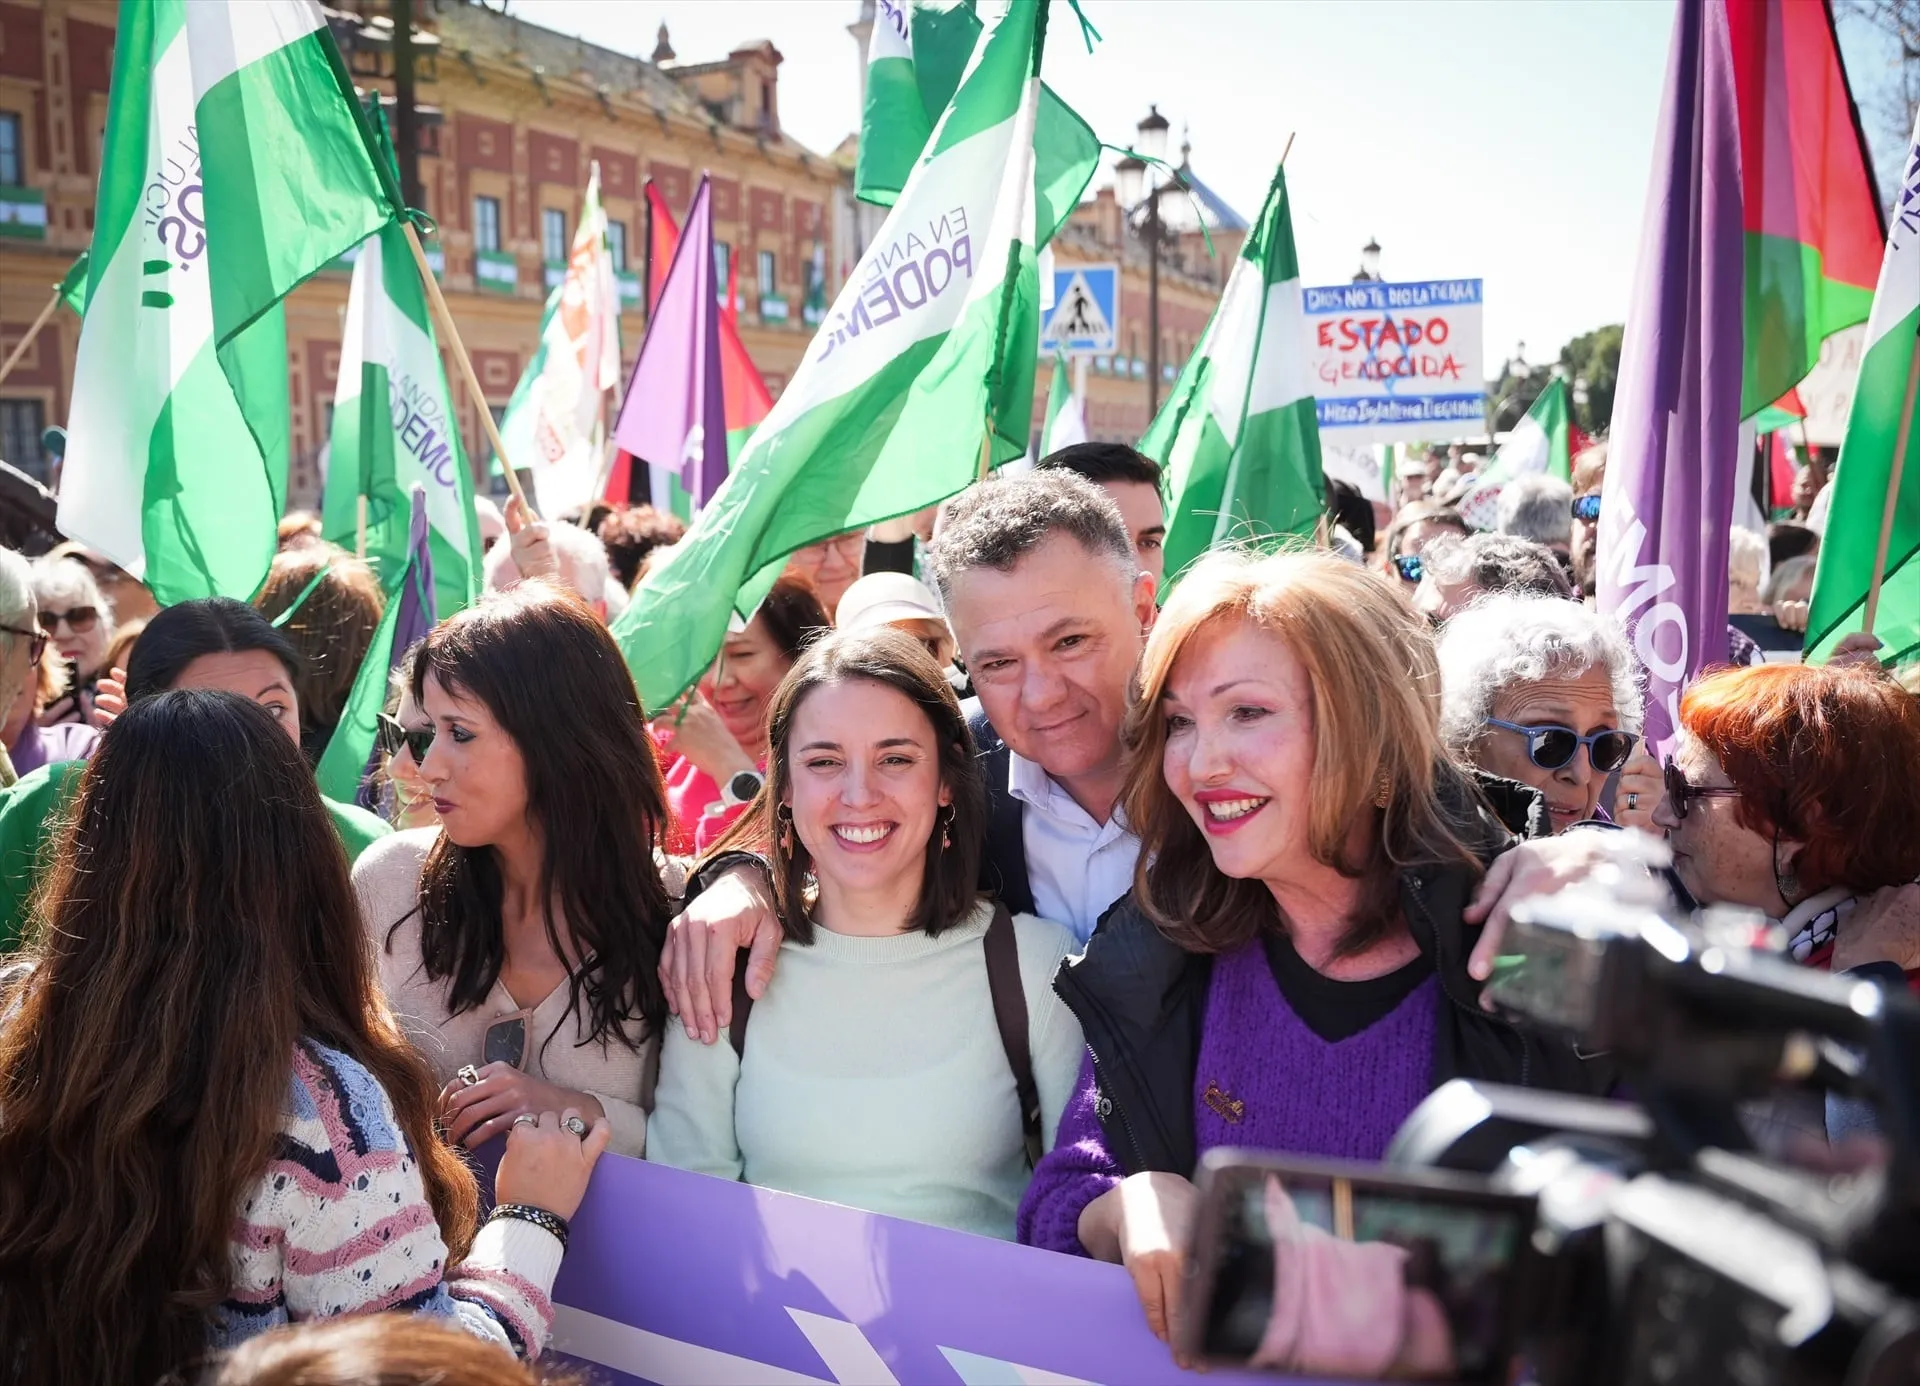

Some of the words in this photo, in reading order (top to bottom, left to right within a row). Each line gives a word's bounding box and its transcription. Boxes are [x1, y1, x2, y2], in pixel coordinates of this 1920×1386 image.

[1307, 289, 1342, 312] DIOS
[1345, 286, 1367, 309] NO
[1316, 317, 1449, 352] ESTADO
[1318, 354, 1465, 386] GENOCIDA
